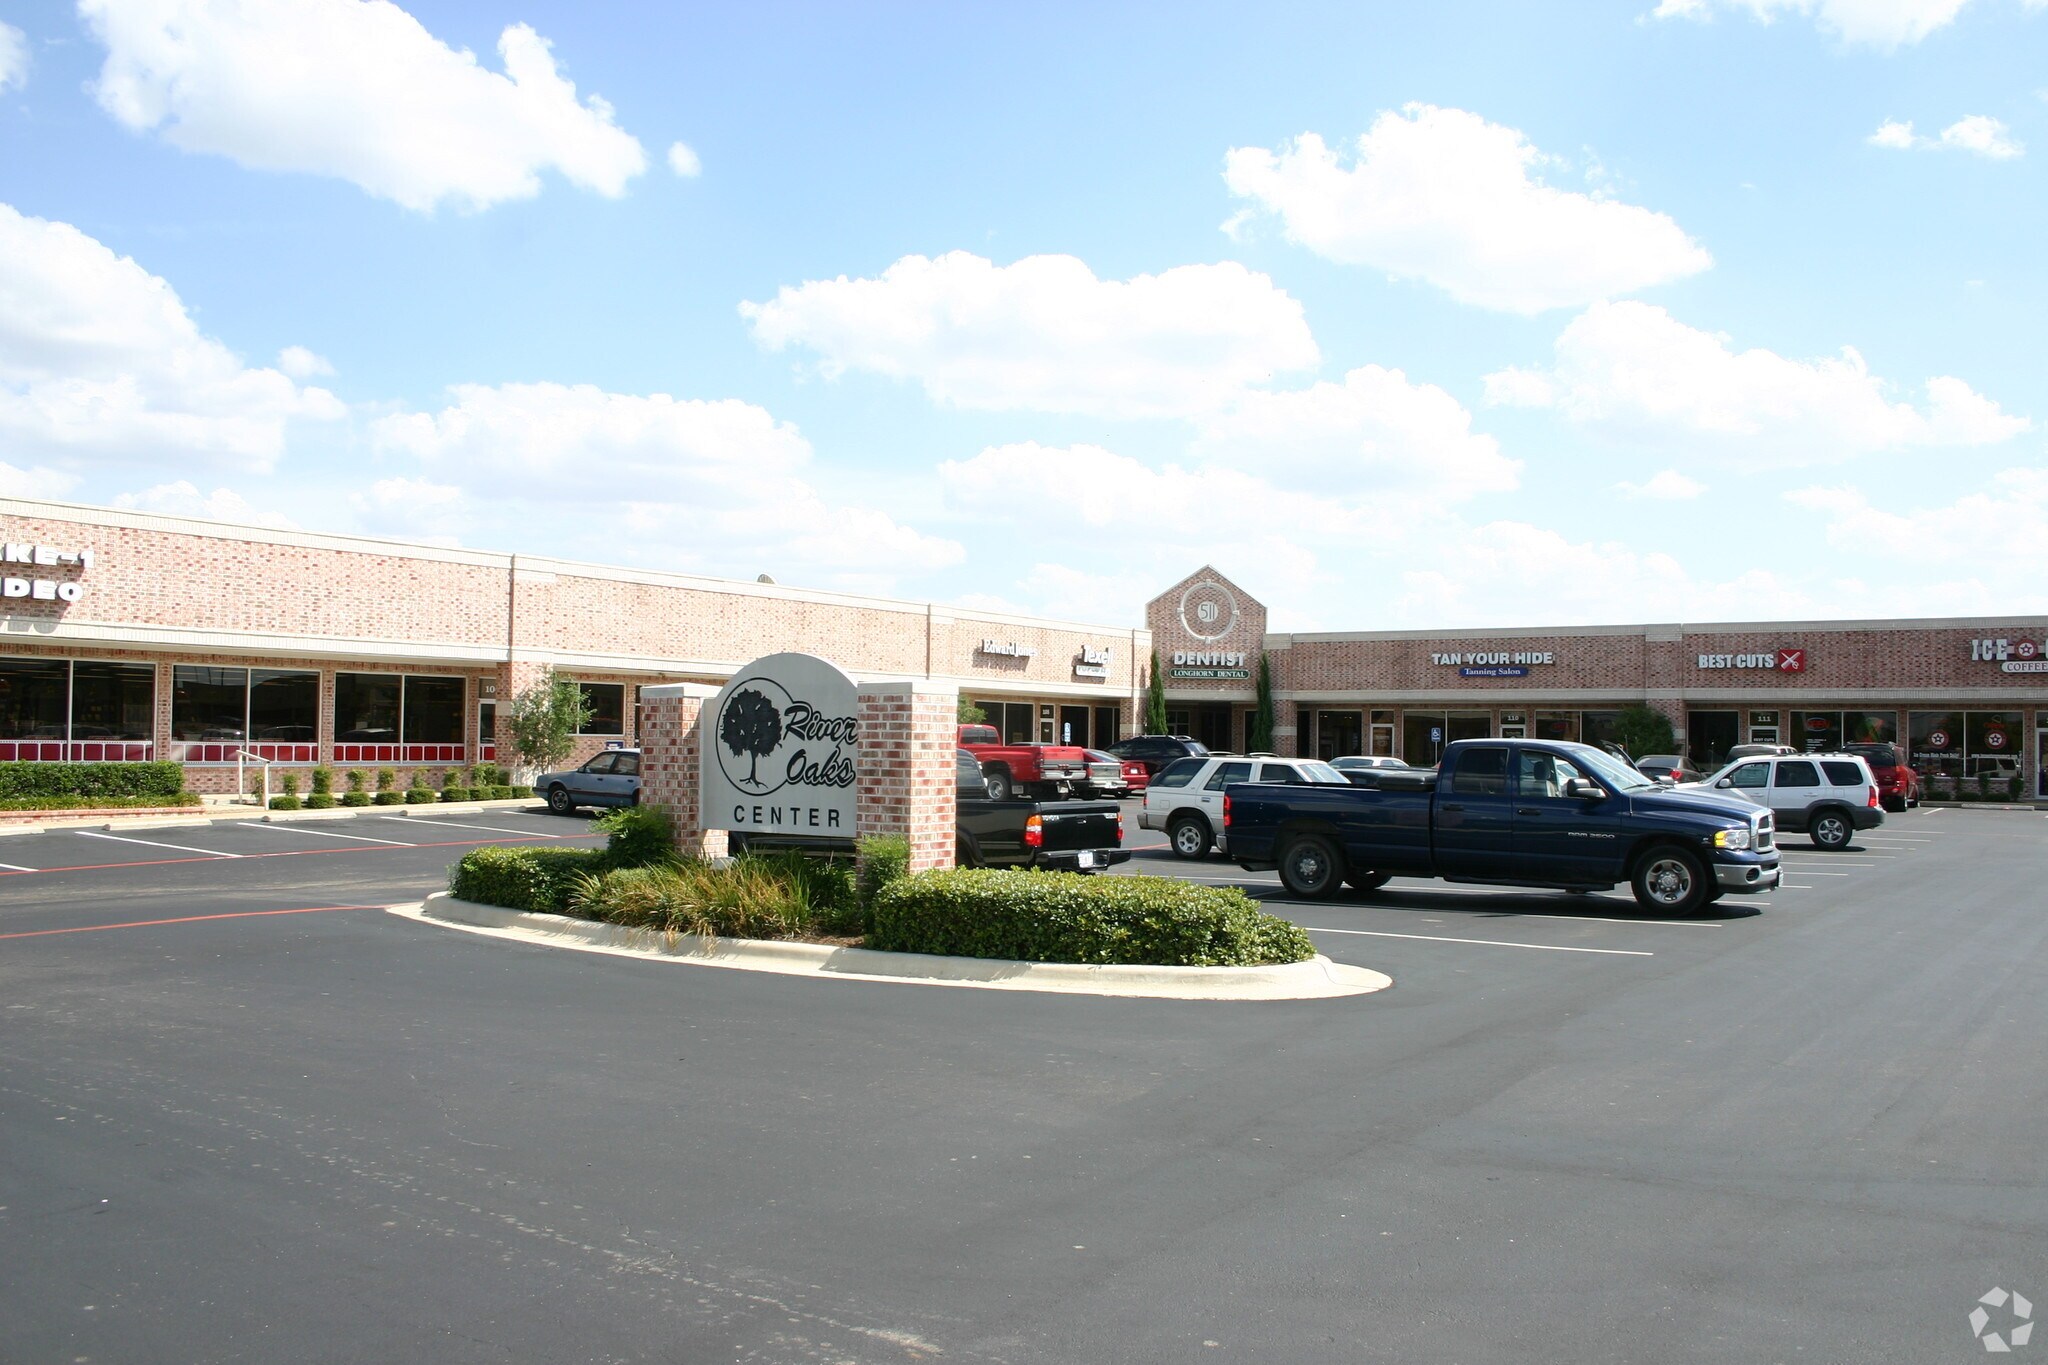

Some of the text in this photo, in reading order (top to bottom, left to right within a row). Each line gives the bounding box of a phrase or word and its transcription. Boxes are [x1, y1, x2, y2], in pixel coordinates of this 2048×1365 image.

[0, 543, 95, 569] KE-1
[0, 577, 84, 602] DEO
[1200, 603, 1215, 619] 511
[1174, 651, 1247, 666] DENTIST
[1431, 652, 1554, 665] TAN YOUR HIDE
[1972, 639, 2008, 660] ICE
[1698, 654, 1774, 668] BEST CUTS
[2007, 663, 2048, 671] COFFEE
[1464, 668, 1522, 676] Tanning Salon
[783, 704, 859, 746] River
[786, 747, 856, 787] Oaks
[733, 805, 840, 828] CENTER
